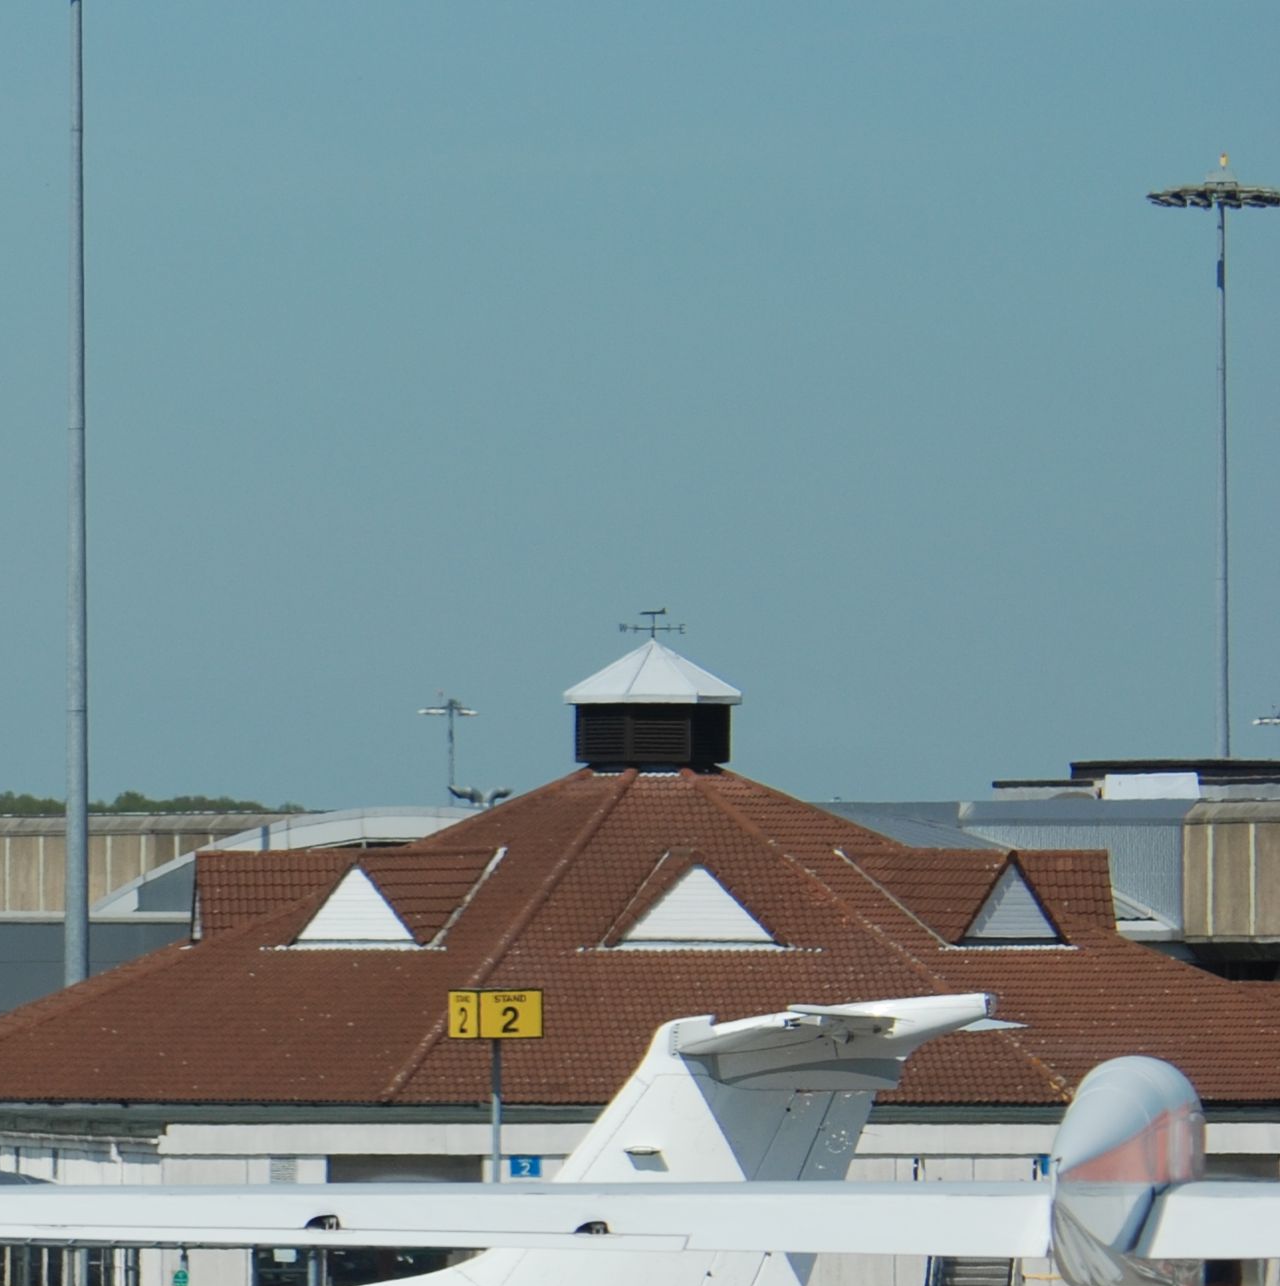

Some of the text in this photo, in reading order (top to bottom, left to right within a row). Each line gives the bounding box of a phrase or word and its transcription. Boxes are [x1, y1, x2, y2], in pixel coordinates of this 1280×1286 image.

[494, 994, 527, 1003] STAND
[458, 1007, 468, 1034] 2
[501, 1006, 520, 1034] 2
